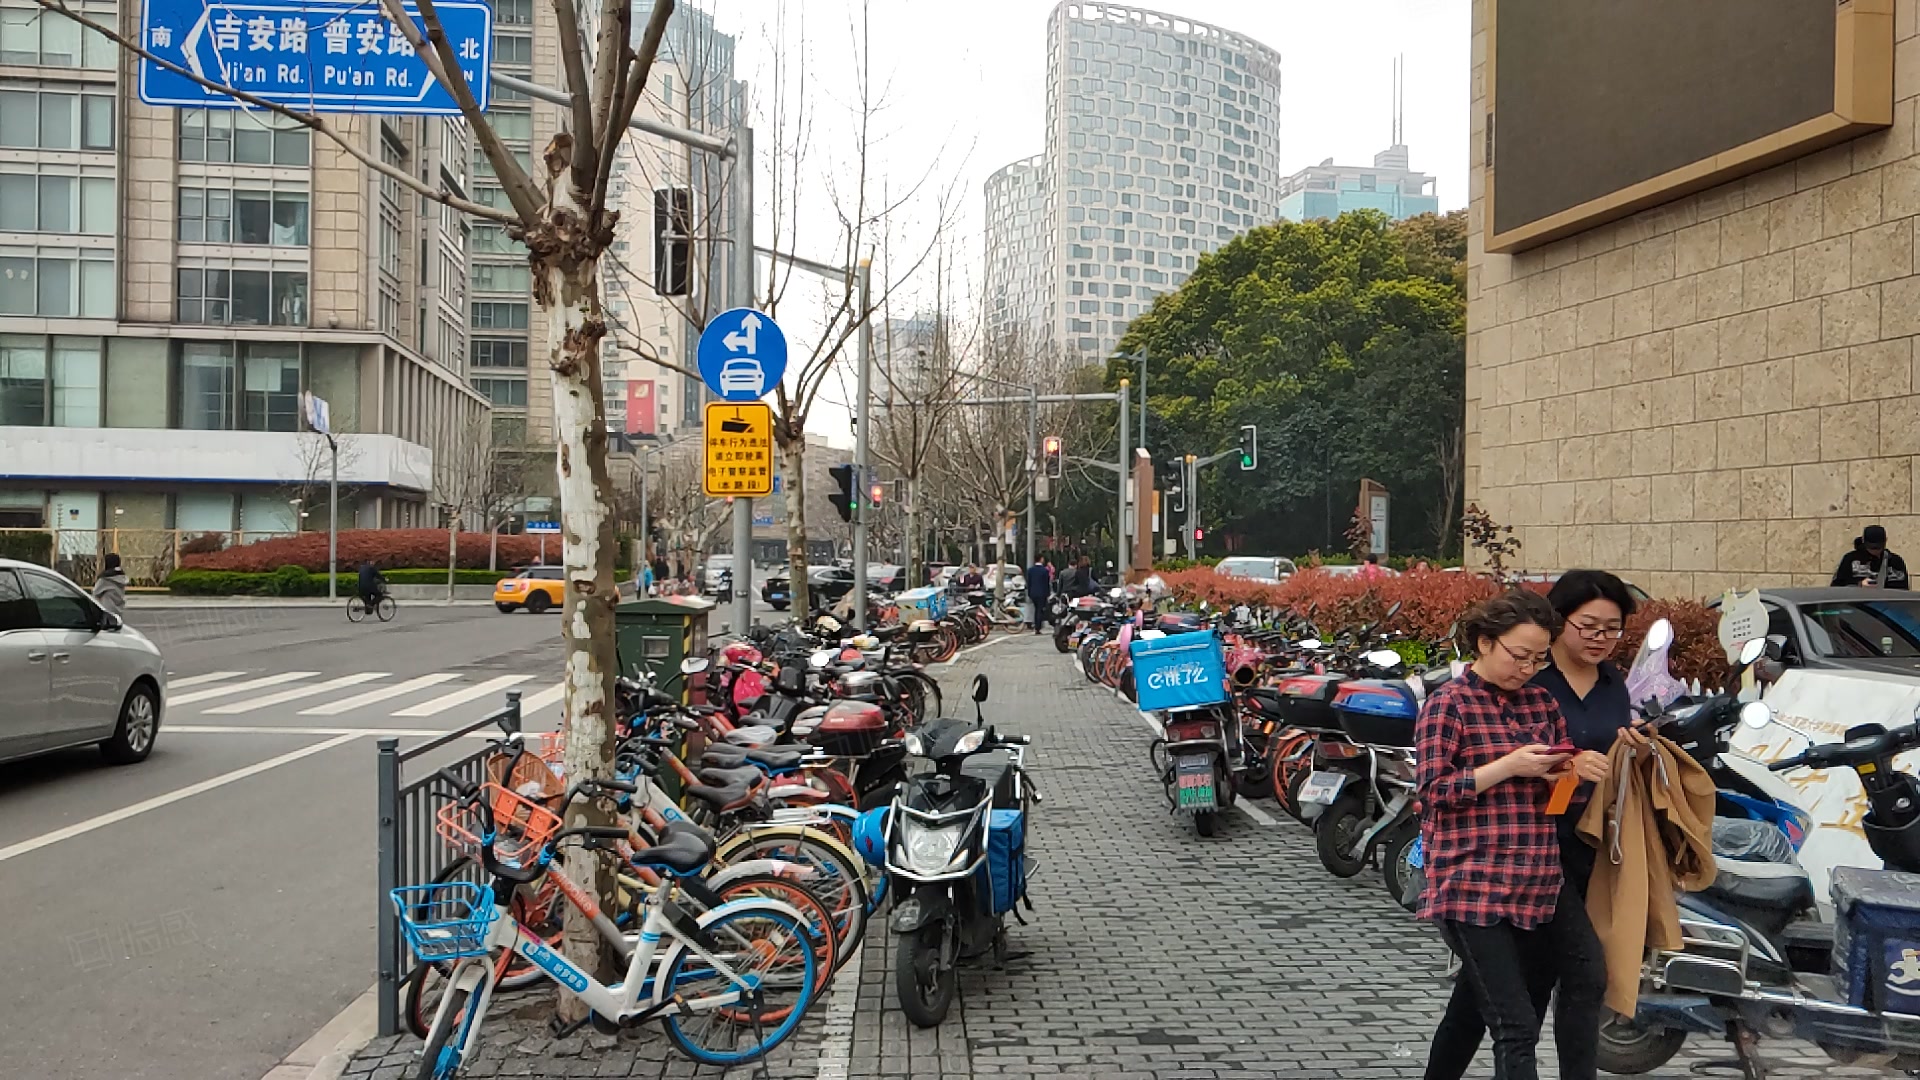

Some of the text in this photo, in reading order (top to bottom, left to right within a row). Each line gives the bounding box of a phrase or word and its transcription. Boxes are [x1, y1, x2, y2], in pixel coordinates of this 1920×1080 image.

[151, 26, 173, 48] 南
[214, 14, 416, 58] 吉安路 普安路
[459, 37, 481, 60] 北
[277, 63, 304, 84] Rd.
[324, 65, 374, 86] Pu'an
[386, 67, 413, 87] Rd.
[463, 70, 474, 82] N
